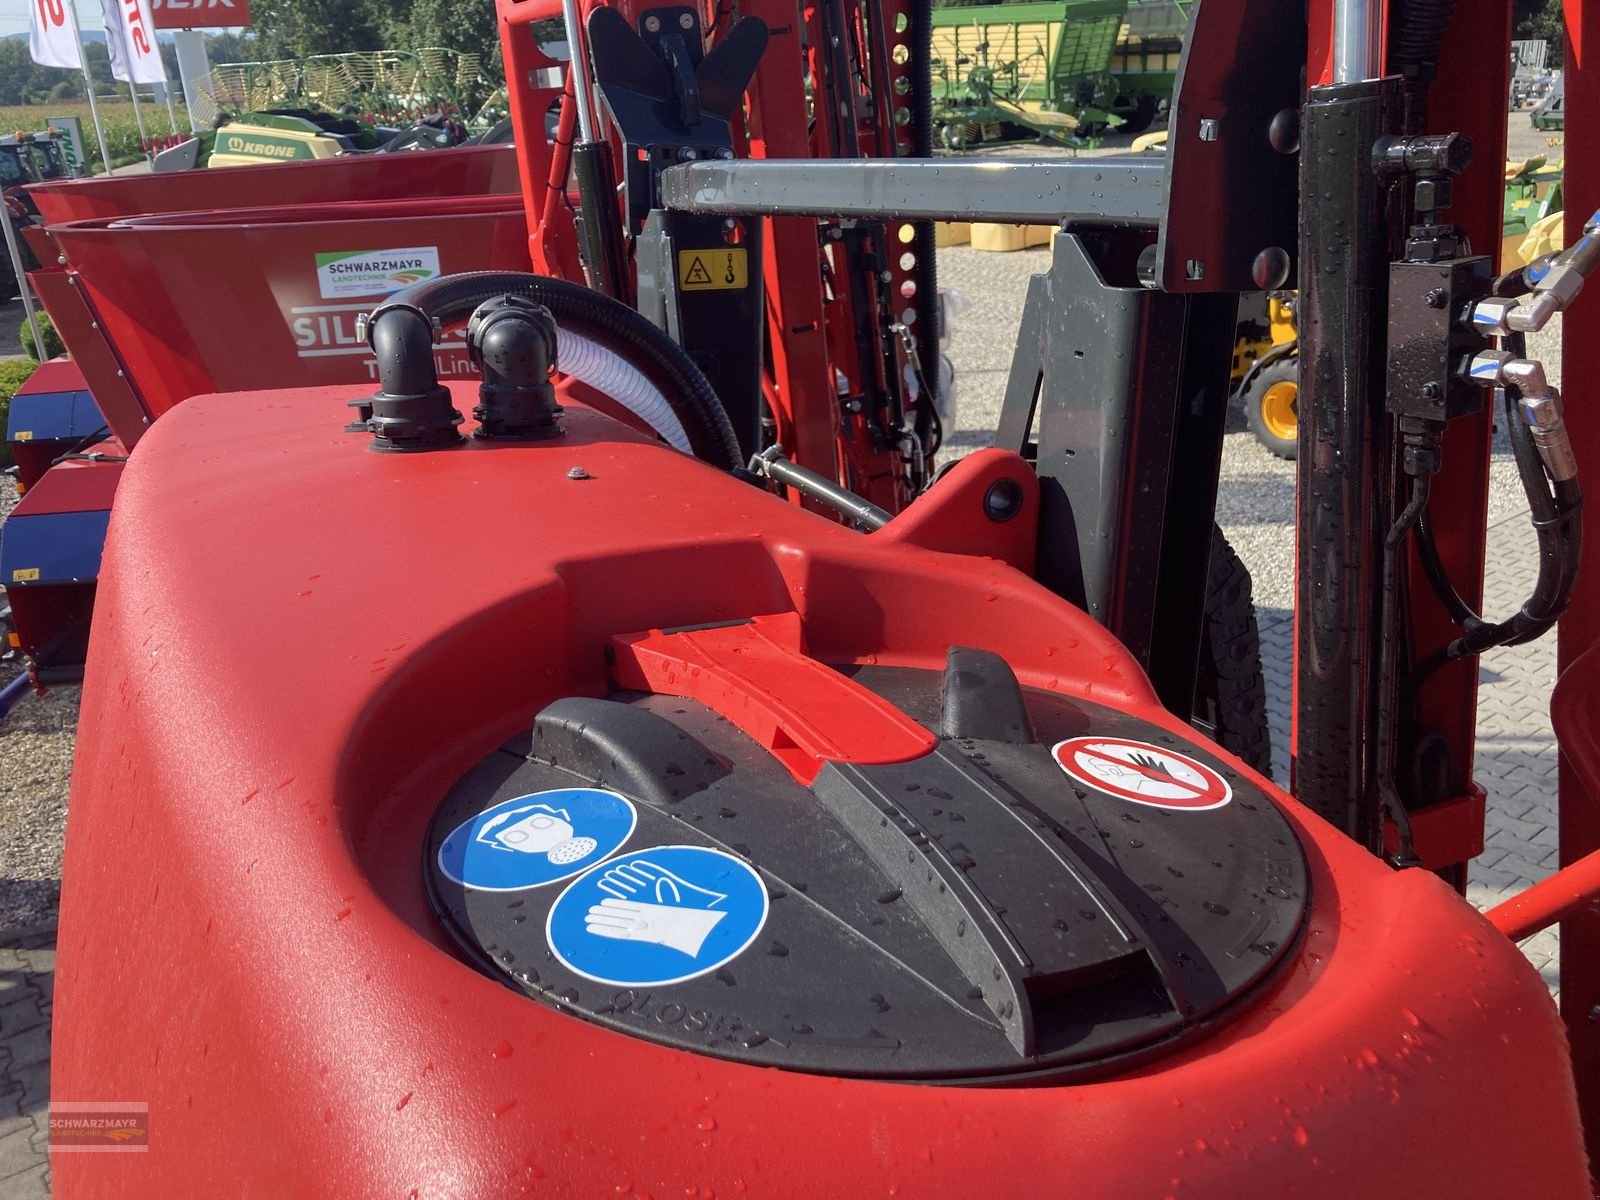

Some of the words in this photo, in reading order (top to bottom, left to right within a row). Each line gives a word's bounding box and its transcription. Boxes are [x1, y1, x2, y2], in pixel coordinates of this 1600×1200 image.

[244, 142, 296, 157] KRONE
[329, 259, 423, 274] SCHWARZMAYR
[332, 273, 388, 283] LANDTECHNIK
